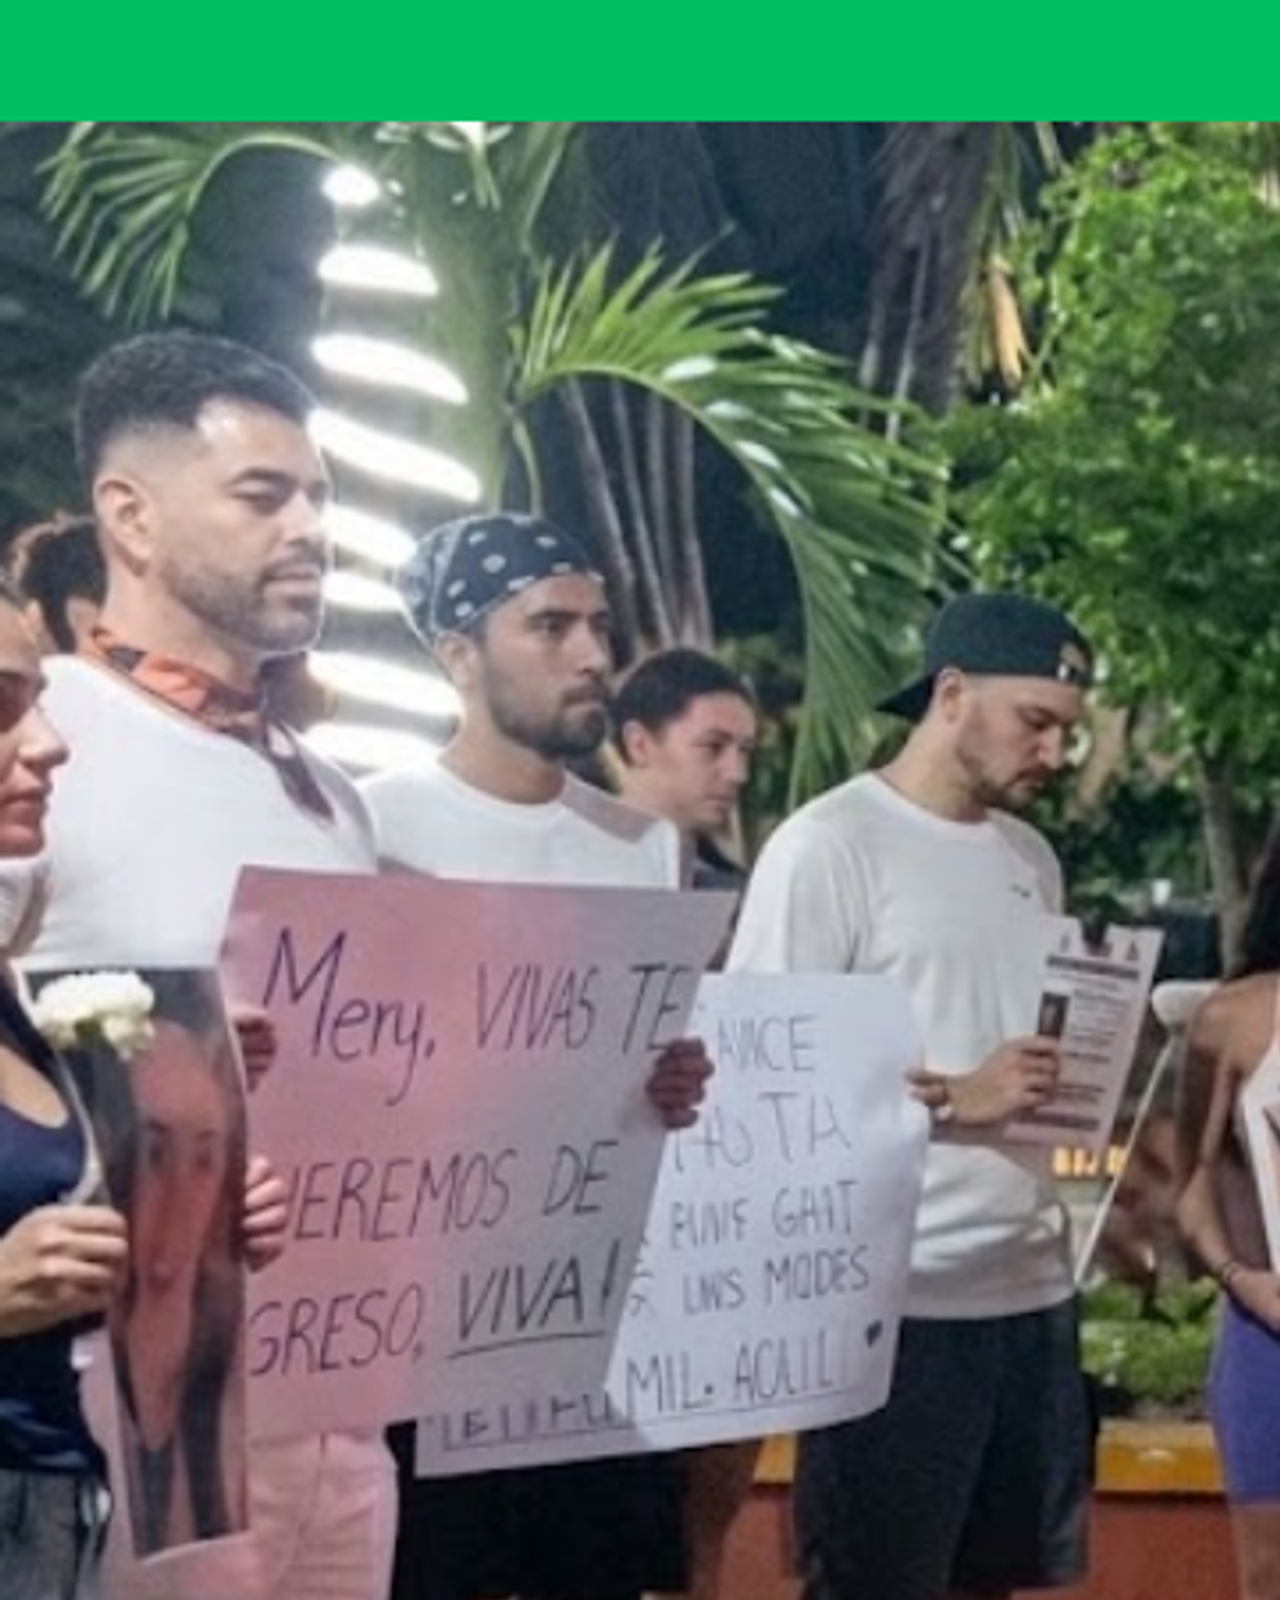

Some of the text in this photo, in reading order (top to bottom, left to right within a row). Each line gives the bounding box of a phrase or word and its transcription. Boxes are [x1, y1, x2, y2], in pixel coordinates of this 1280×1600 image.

[262, 926, 436, 1107] Mery,
[475, 962, 599, 1054] VIVAS
[543, 1140, 620, 1217] DE
